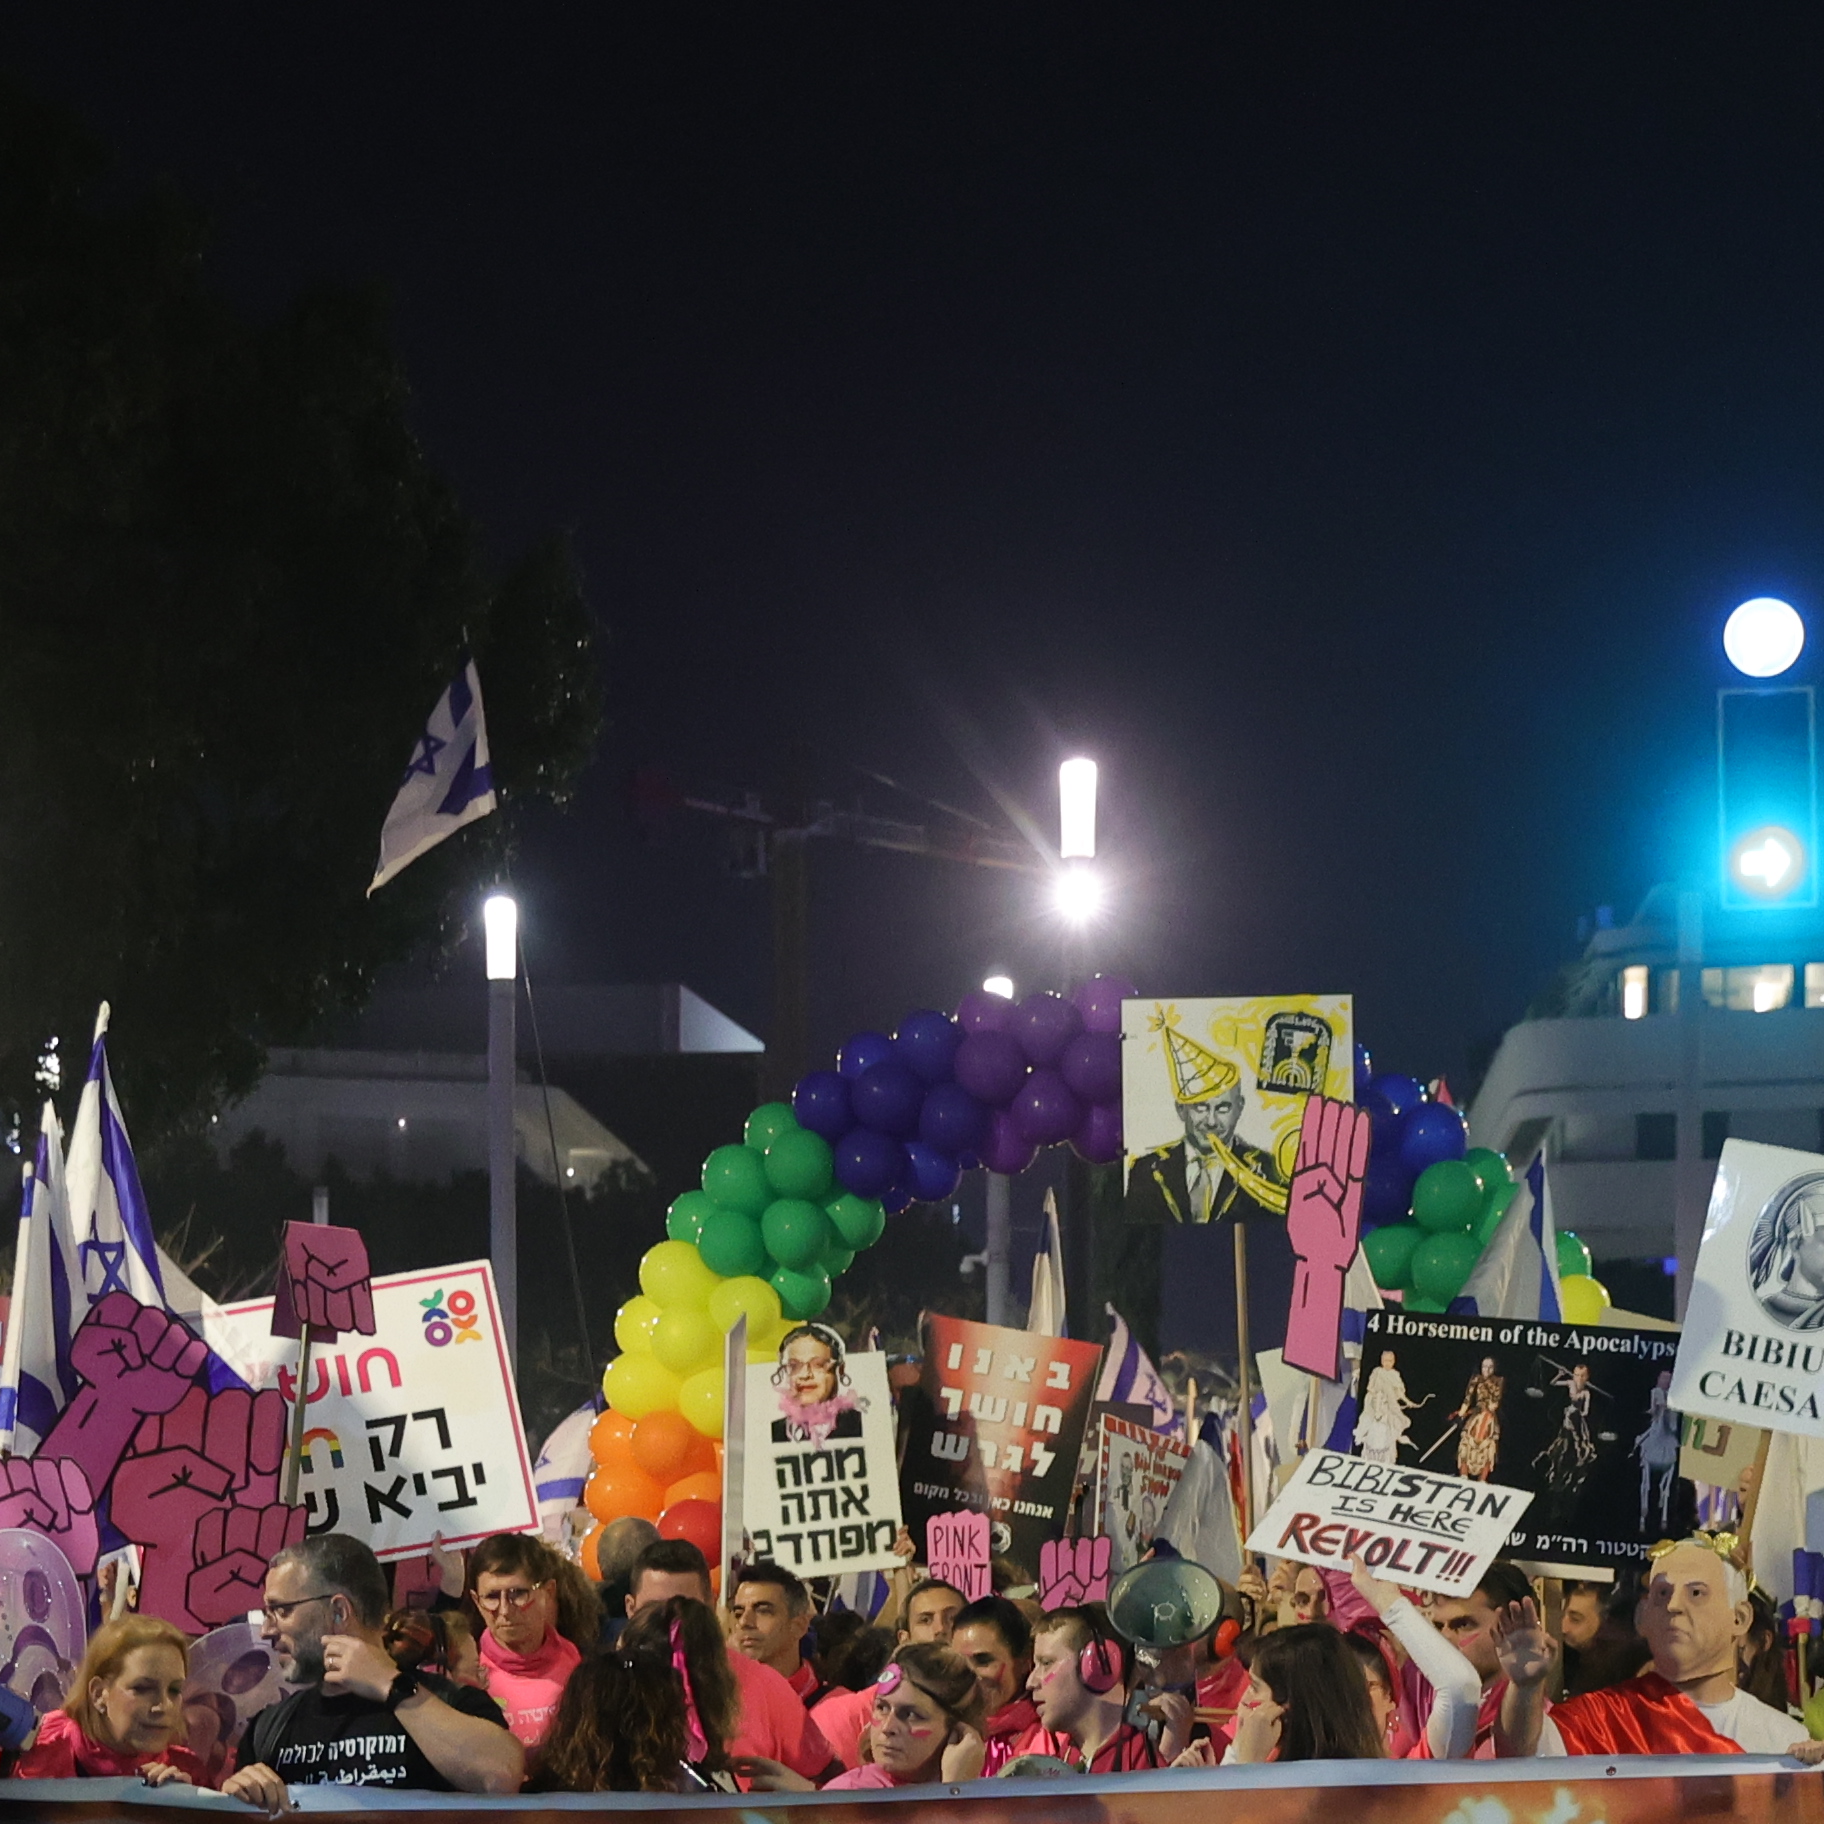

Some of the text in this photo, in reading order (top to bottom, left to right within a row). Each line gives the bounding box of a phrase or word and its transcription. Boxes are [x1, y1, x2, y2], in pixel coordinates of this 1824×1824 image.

[1366, 1312, 1678, 1360] 4 Horsemen of the Apocalyps
[277, 1347, 402, 1404] חוש
[947, 1342, 1072, 1391] באנו
[940, 1386, 1064, 1435] חושך
[365, 1407, 452, 1473] רק
[930, 1430, 1057, 1478] לגרש
[774, 1445, 868, 1489] ממה
[1306, 1454, 1512, 1520] BIBISTAN
[363, 1461, 487, 1524] יביא
[780, 1483, 870, 1526] אתה
[913, 1481, 950, 1501] מקום
[1012, 1498, 1055, 1520] אנחנו
[1331, 1495, 1474, 1535] IS HERE
[932, 1524, 983, 1559] PINK
[1277, 1511, 1478, 1585] REVOLT!!!
[1595, 1539, 1653, 1562] קטטור
[930, 1561, 988, 1597] FRONT
[328, 1733, 407, 1763] דמוקרטיה
